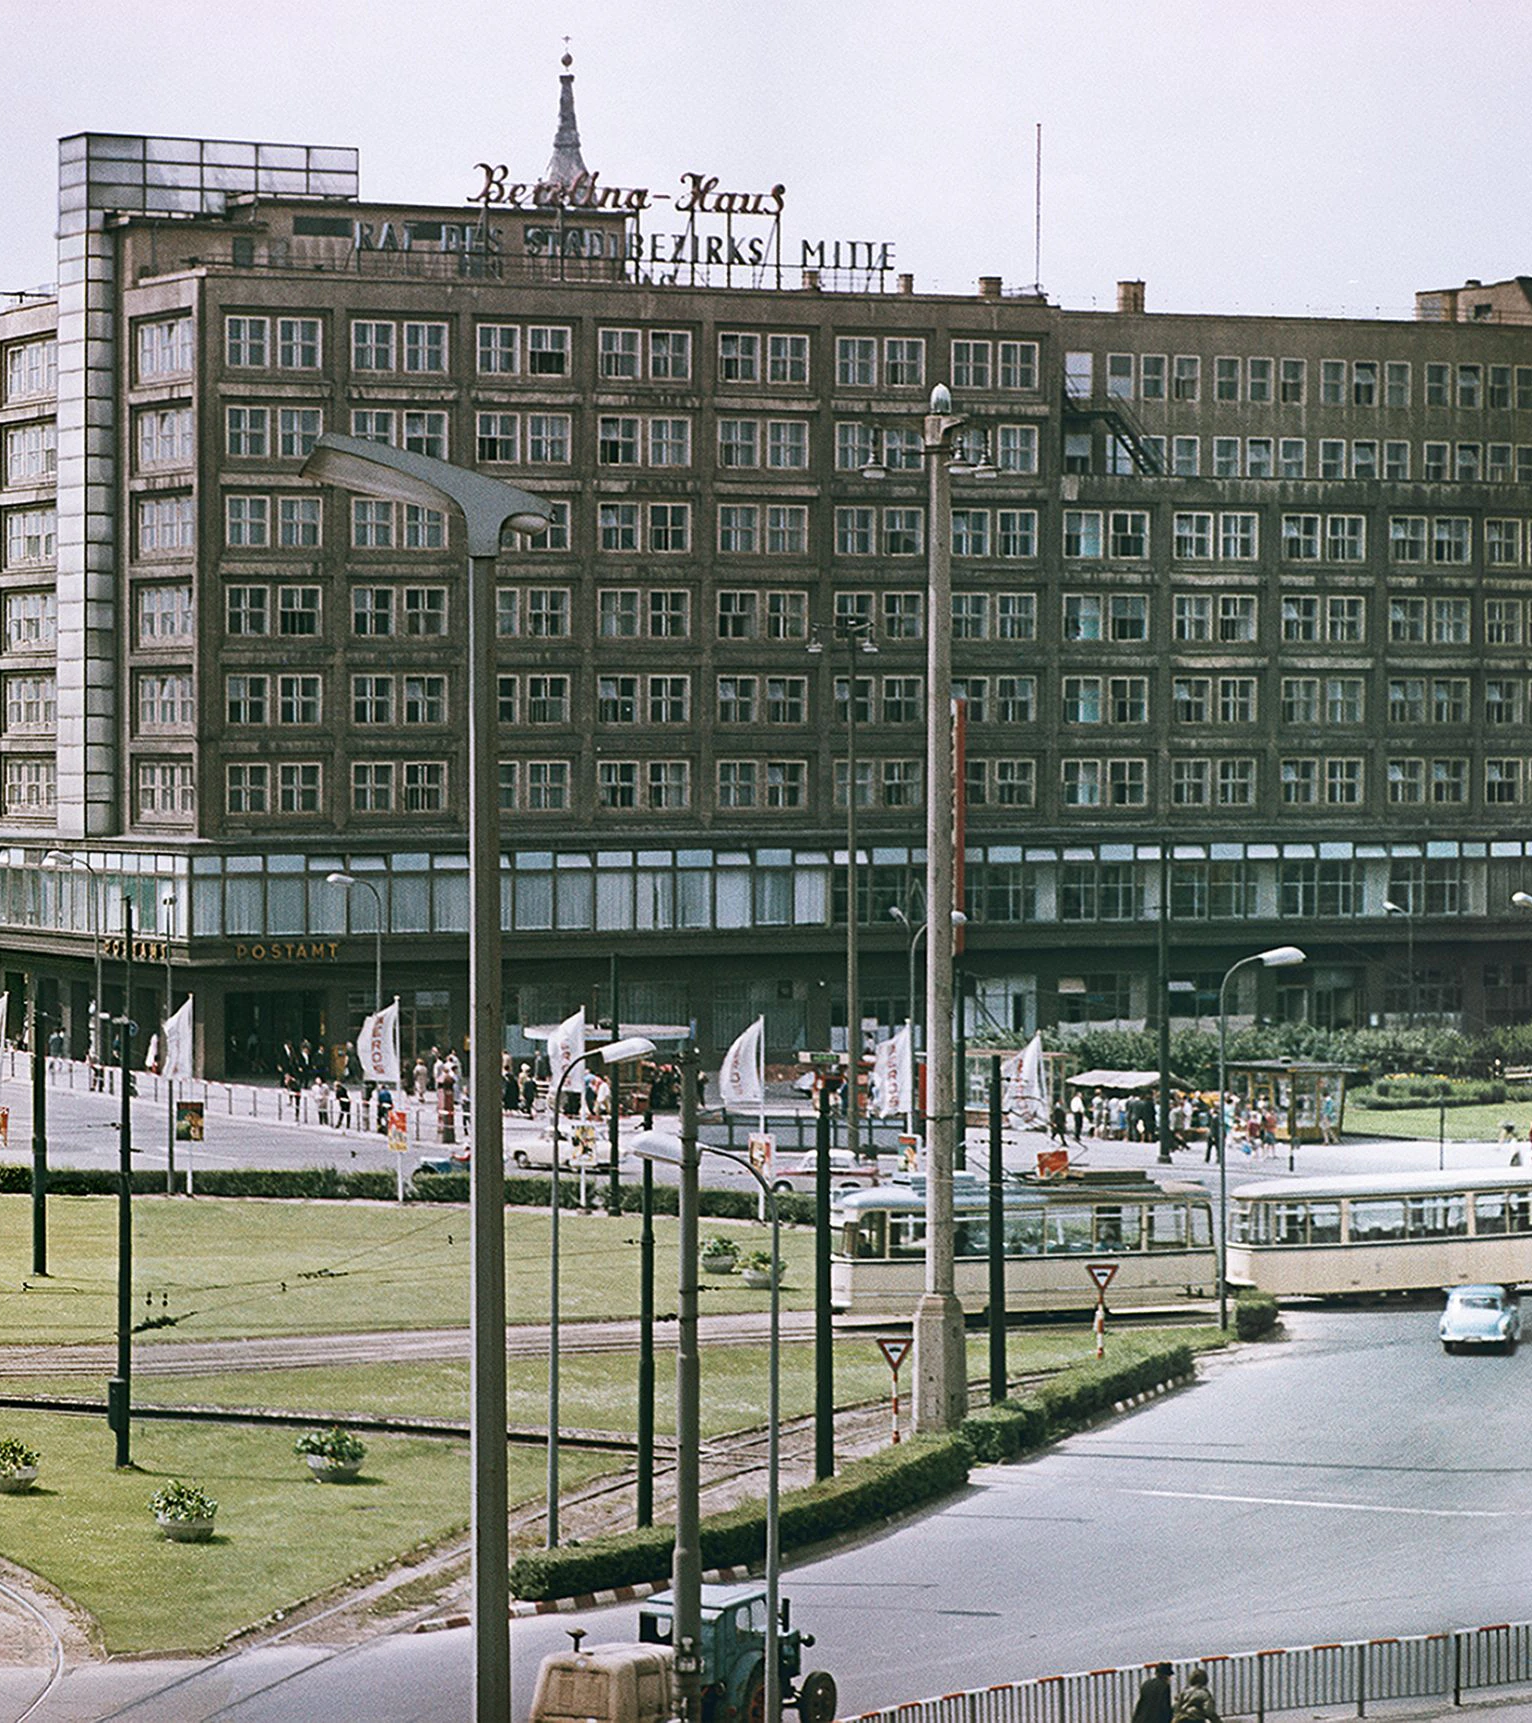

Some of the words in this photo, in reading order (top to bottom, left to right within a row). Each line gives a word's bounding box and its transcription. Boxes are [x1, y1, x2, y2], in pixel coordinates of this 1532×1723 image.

[355, 220, 419, 252] RAT
[440, 223, 504, 257] DES
[800, 238, 897, 271] MITTE
[236, 942, 340, 962] POSTAMT
